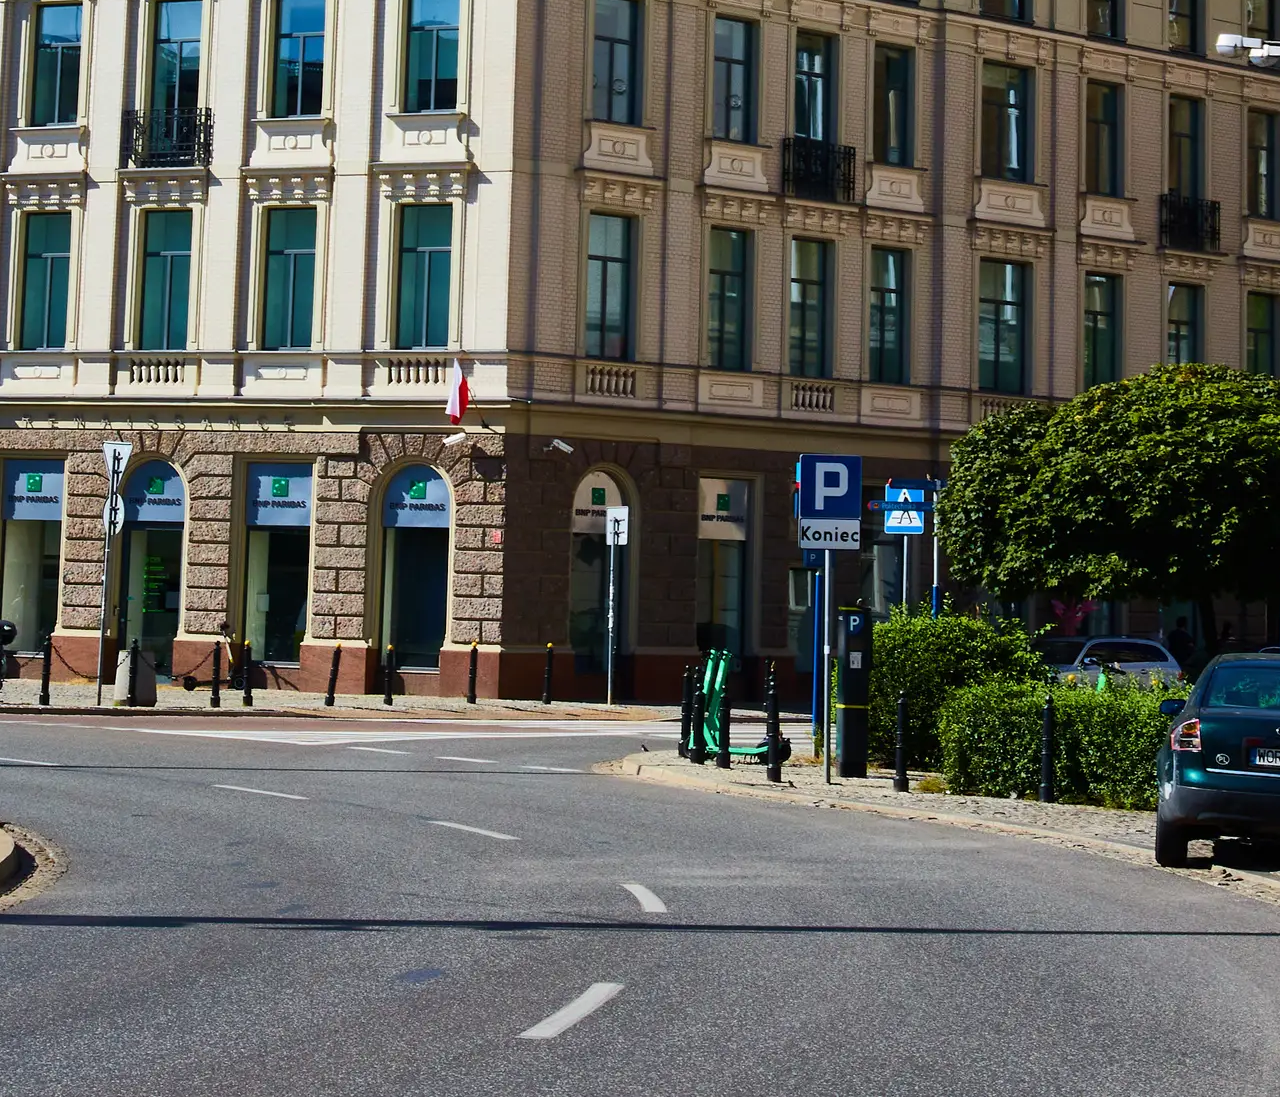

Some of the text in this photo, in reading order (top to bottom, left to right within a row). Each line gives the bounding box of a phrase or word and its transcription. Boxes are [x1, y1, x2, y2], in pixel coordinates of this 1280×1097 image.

[814, 462, 849, 511] P
[26, 495, 59, 504] PARIBAS
[147, 498, 182, 507] PARIBAS
[271, 500, 307, 509] PARIBAS
[409, 503, 447, 512] PARIBAS
[701, 514, 745, 523] BNP PARIBAS
[801, 526, 859, 543] Koniec
[849, 615, 860, 631] P
